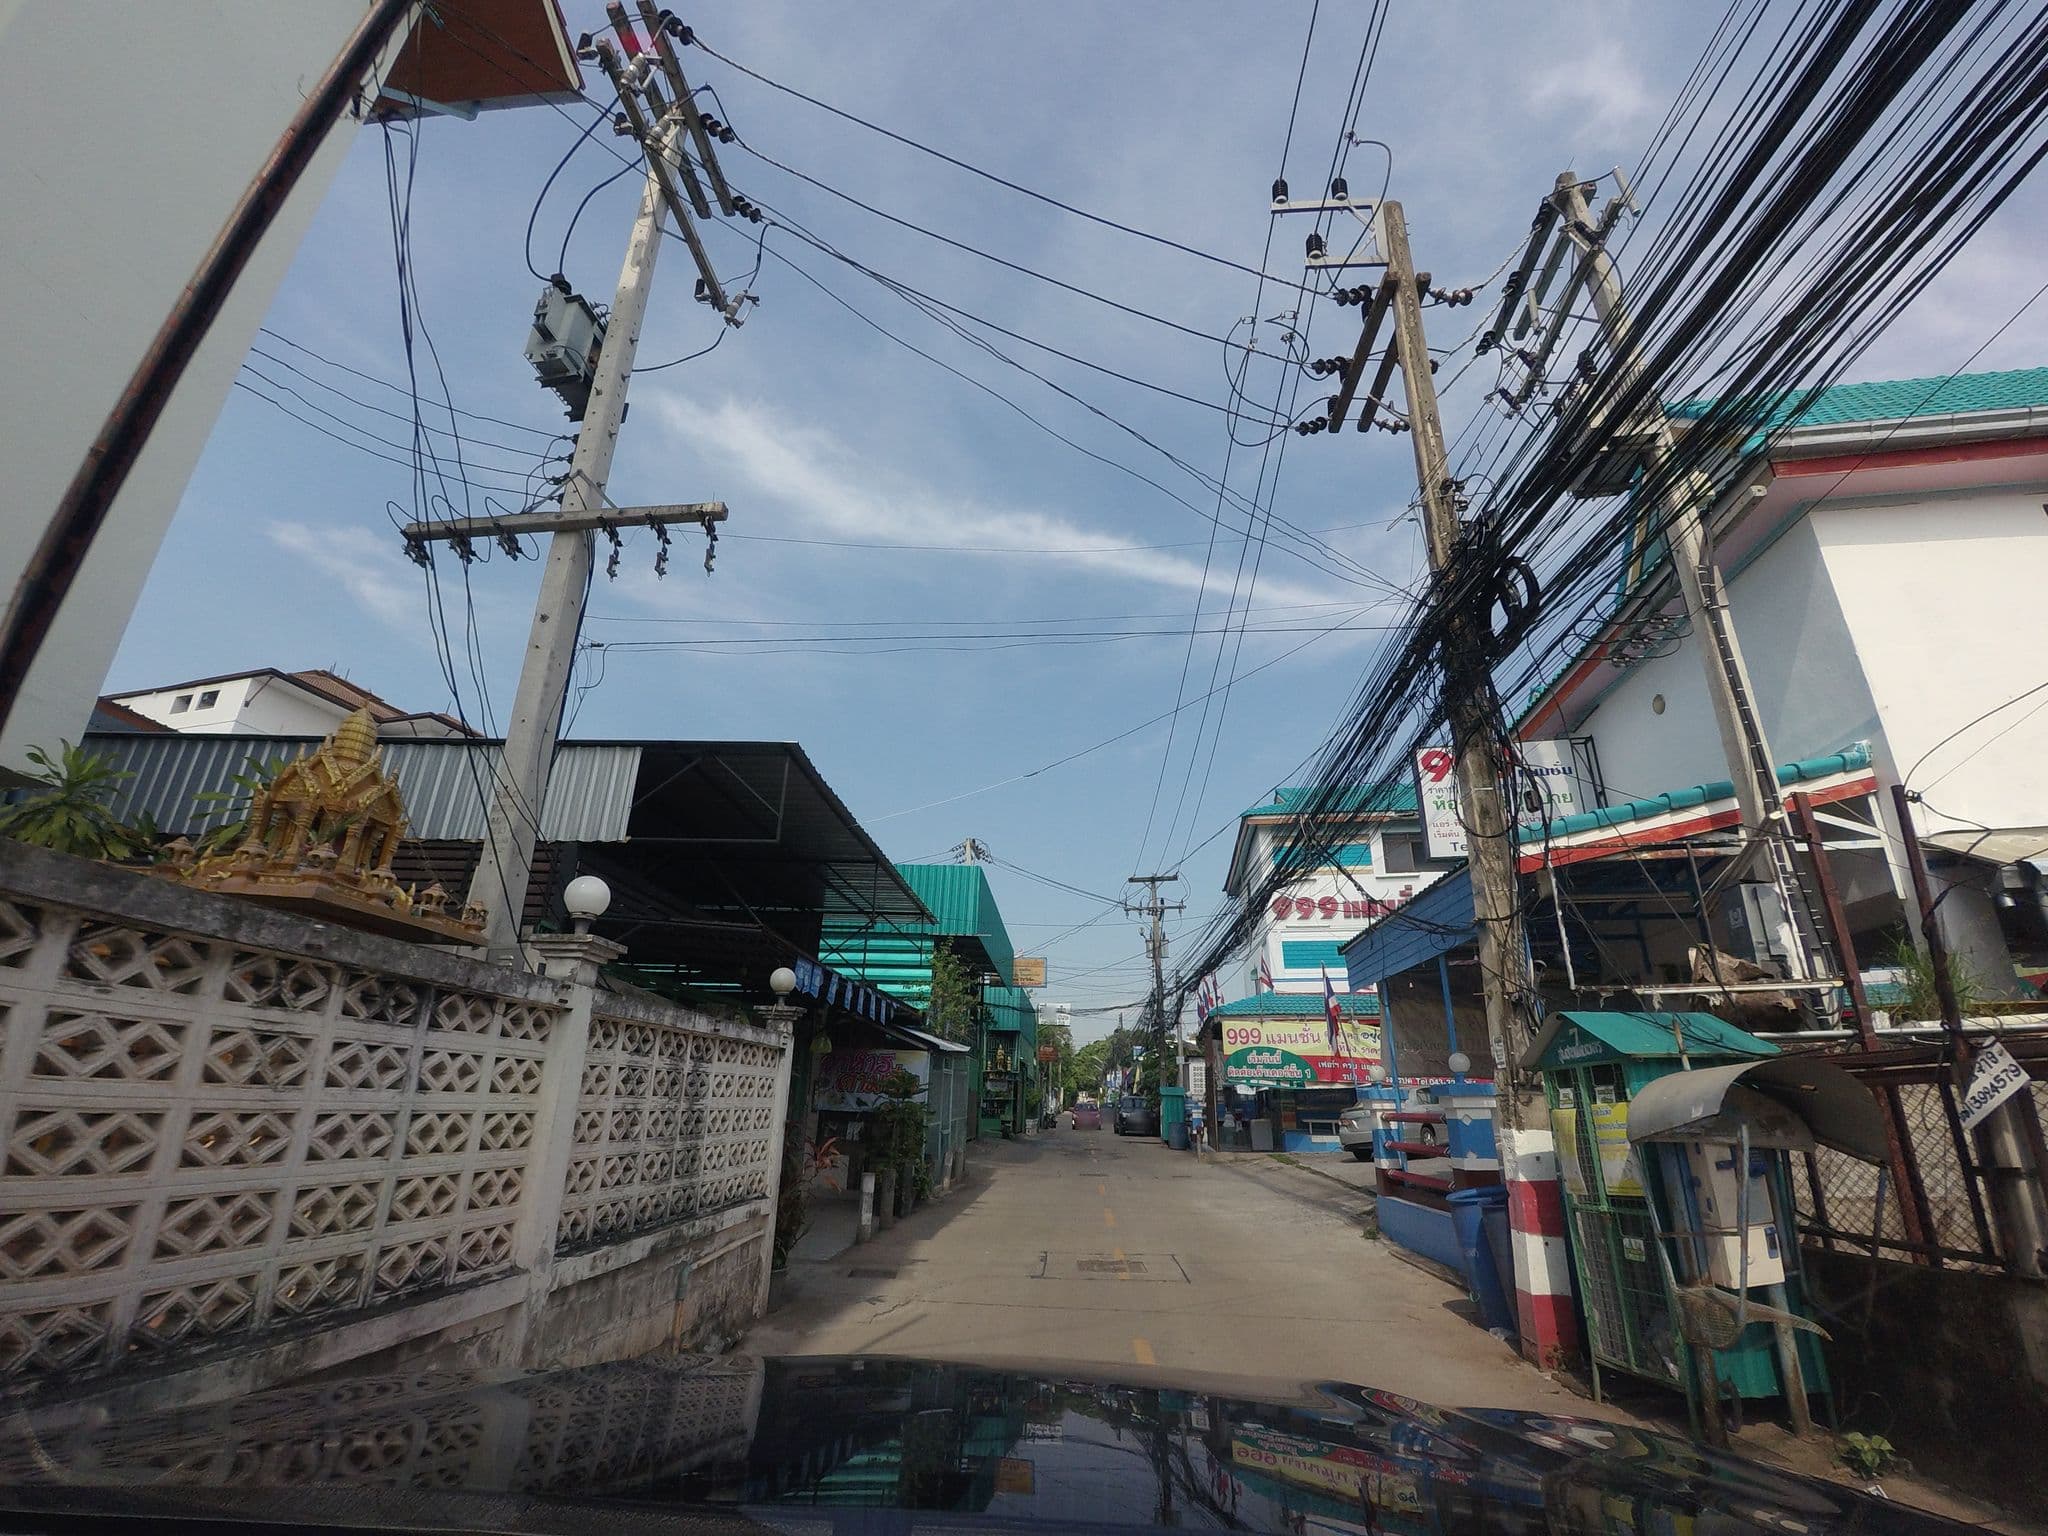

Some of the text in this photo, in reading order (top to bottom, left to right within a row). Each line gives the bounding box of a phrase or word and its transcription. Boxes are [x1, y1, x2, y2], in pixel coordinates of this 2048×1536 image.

[1449, 841, 1469, 852] Te
[1272, 895, 1339, 920] 999
[1226, 1027, 1262, 1046] 999
[1266, 1023, 1322, 1045] แมนชั่น
